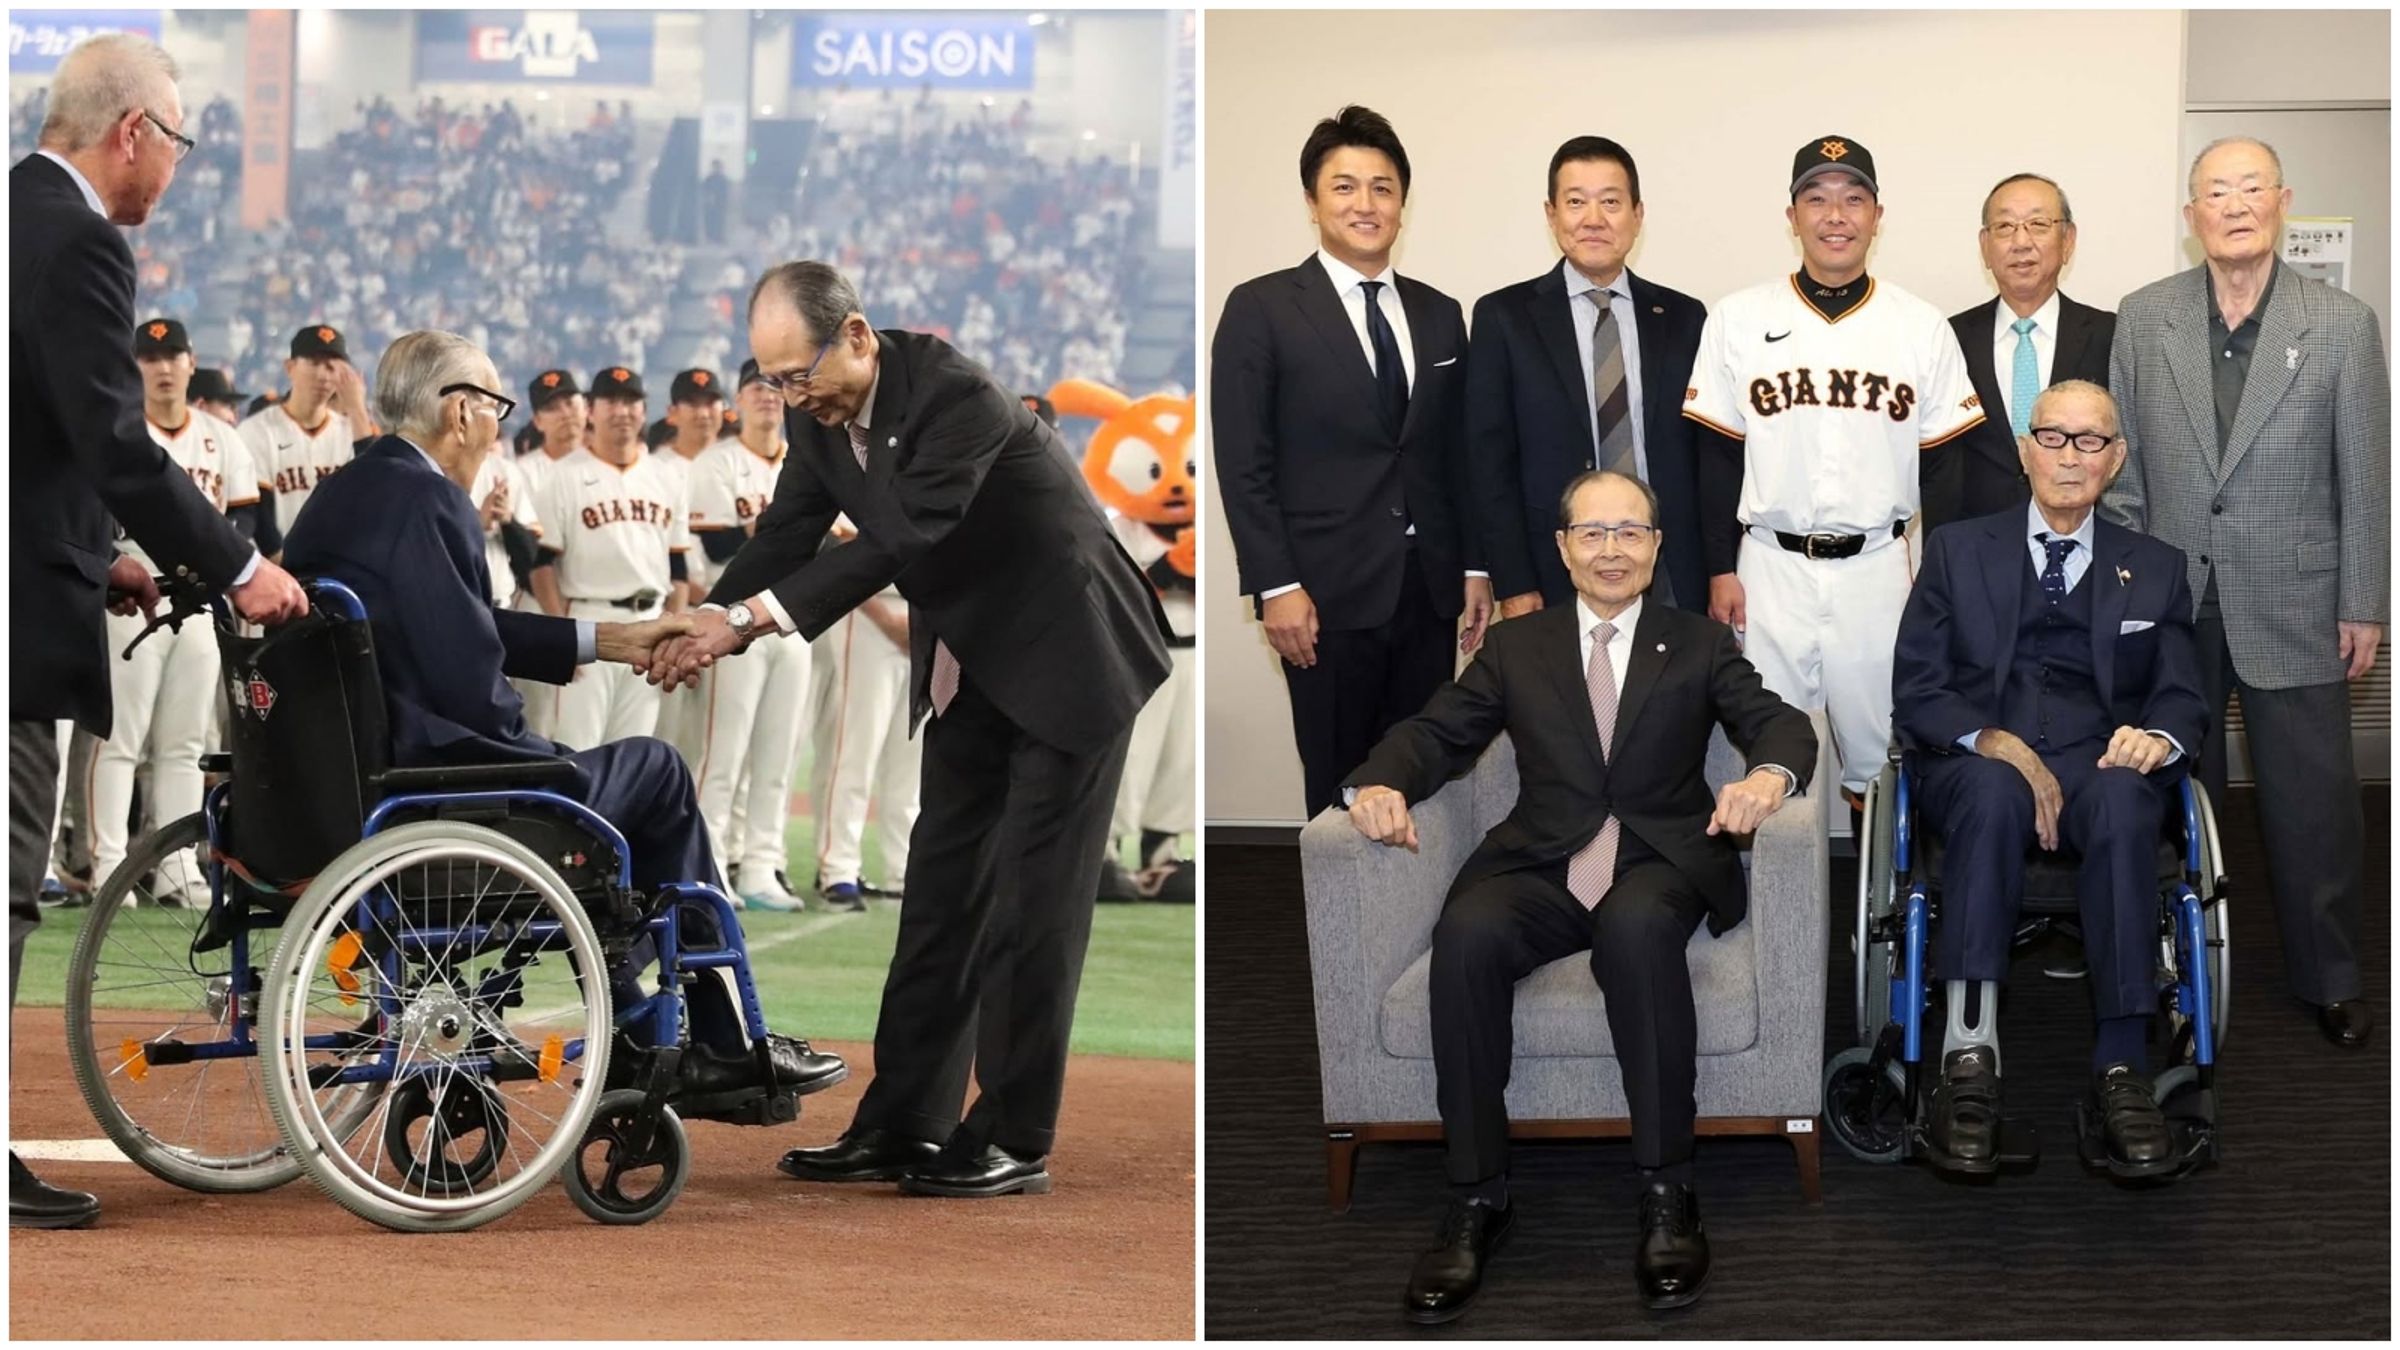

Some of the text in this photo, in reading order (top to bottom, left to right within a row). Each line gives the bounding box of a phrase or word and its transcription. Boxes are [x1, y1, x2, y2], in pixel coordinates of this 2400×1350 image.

[812, 29, 1015, 77] SAISON
[1750, 367, 1916, 422] GIANTS
[204, 438, 215, 453] C
[581, 499, 672, 530] GIANTS
